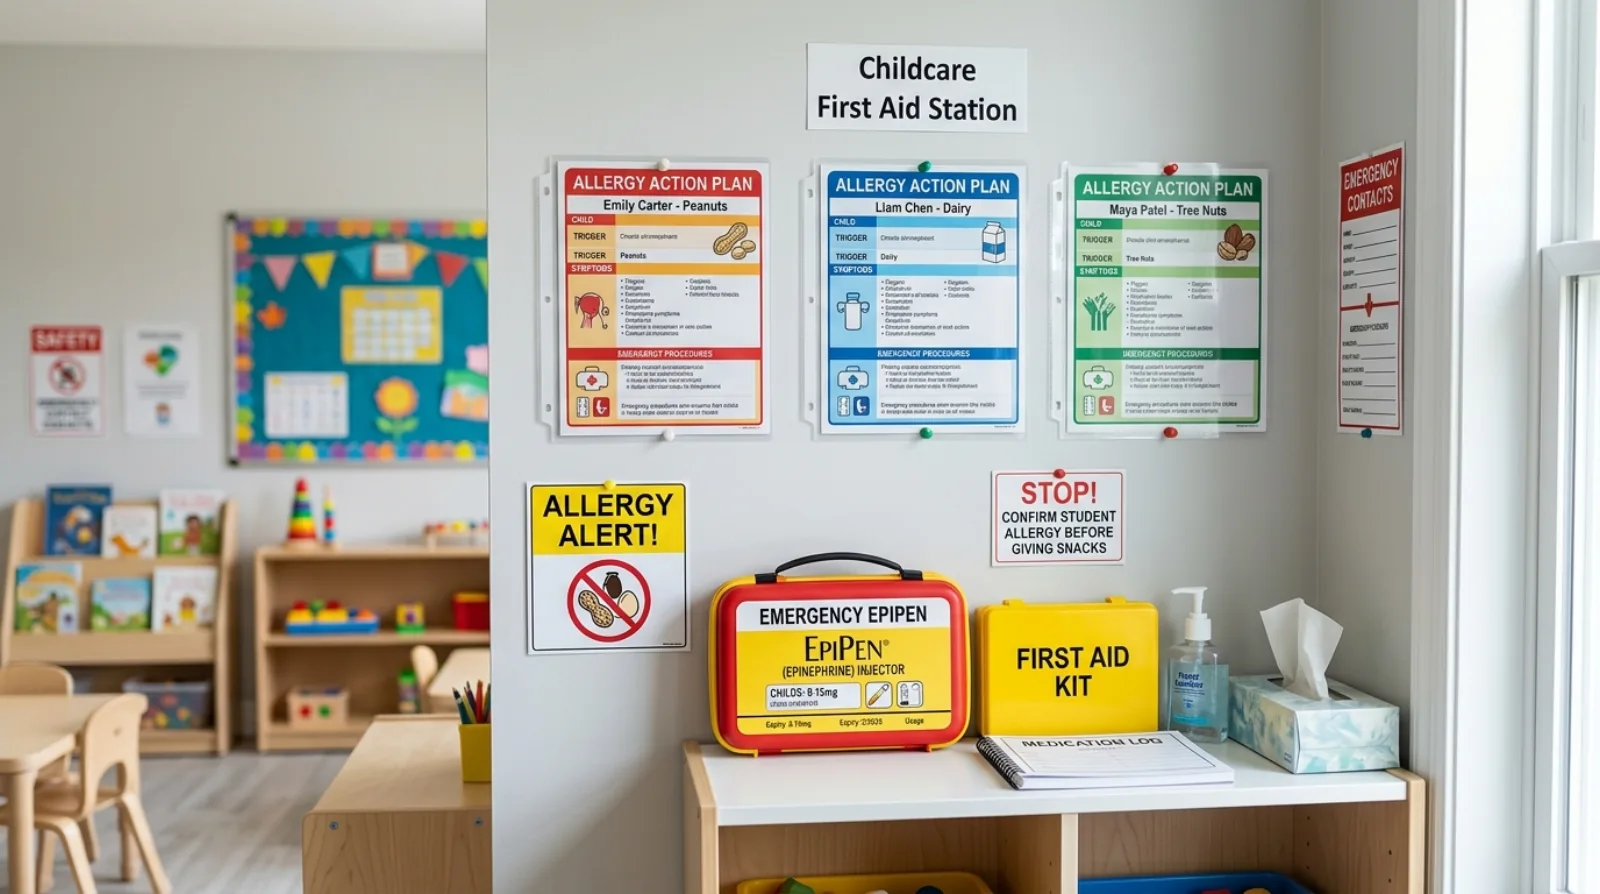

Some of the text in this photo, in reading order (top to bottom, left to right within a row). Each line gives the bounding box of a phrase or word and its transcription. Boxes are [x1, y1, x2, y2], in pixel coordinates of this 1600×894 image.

[859, 55, 977, 81] Childcare
[818, 94, 1017, 121] First Aid Station
[1343, 157, 1400, 190] EMERGENCY
[573, 175, 753, 191] ALLERGY ACTION PLAN
[835, 178, 1010, 194] ALLERGY ACTION PLAN
[1082, 181, 1253, 196] ALLERGY ACTION PLAN
[603, 199, 634, 213] Emily
[637, 200, 673, 211] Carter
[683, 200, 728, 212] Peanuts
[1347, 184, 1394, 213] CONTACTS
[905, 201, 933, 213] Chen
[943, 202, 972, 216] Dairy
[1109, 204, 1138, 217] Maya
[1140, 204, 1167, 216] Patel
[1176, 204, 1200, 216] Tree
[1202, 205, 1227, 216] Nuts
[1021, 481, 1097, 504] STOP!
[542, 493, 674, 518] ALLERGY
[1001, 510, 1117, 523] CONFIRM STUDENT
[558, 523, 658, 547] ALERT!
[1004, 526, 1114, 539] ALLERGY BEFORE
[1011, 542, 1107, 554] GIVING SNACKS
[759, 605, 927, 625] EMERGENCY EPIPEN
[1017, 645, 1130, 669] FIRST AID
[782, 664, 905, 679] (EPINEPHRINE) INJECTOR
[1055, 675, 1093, 697] KIT
[1021, 739, 1126, 747] MEDICATION
